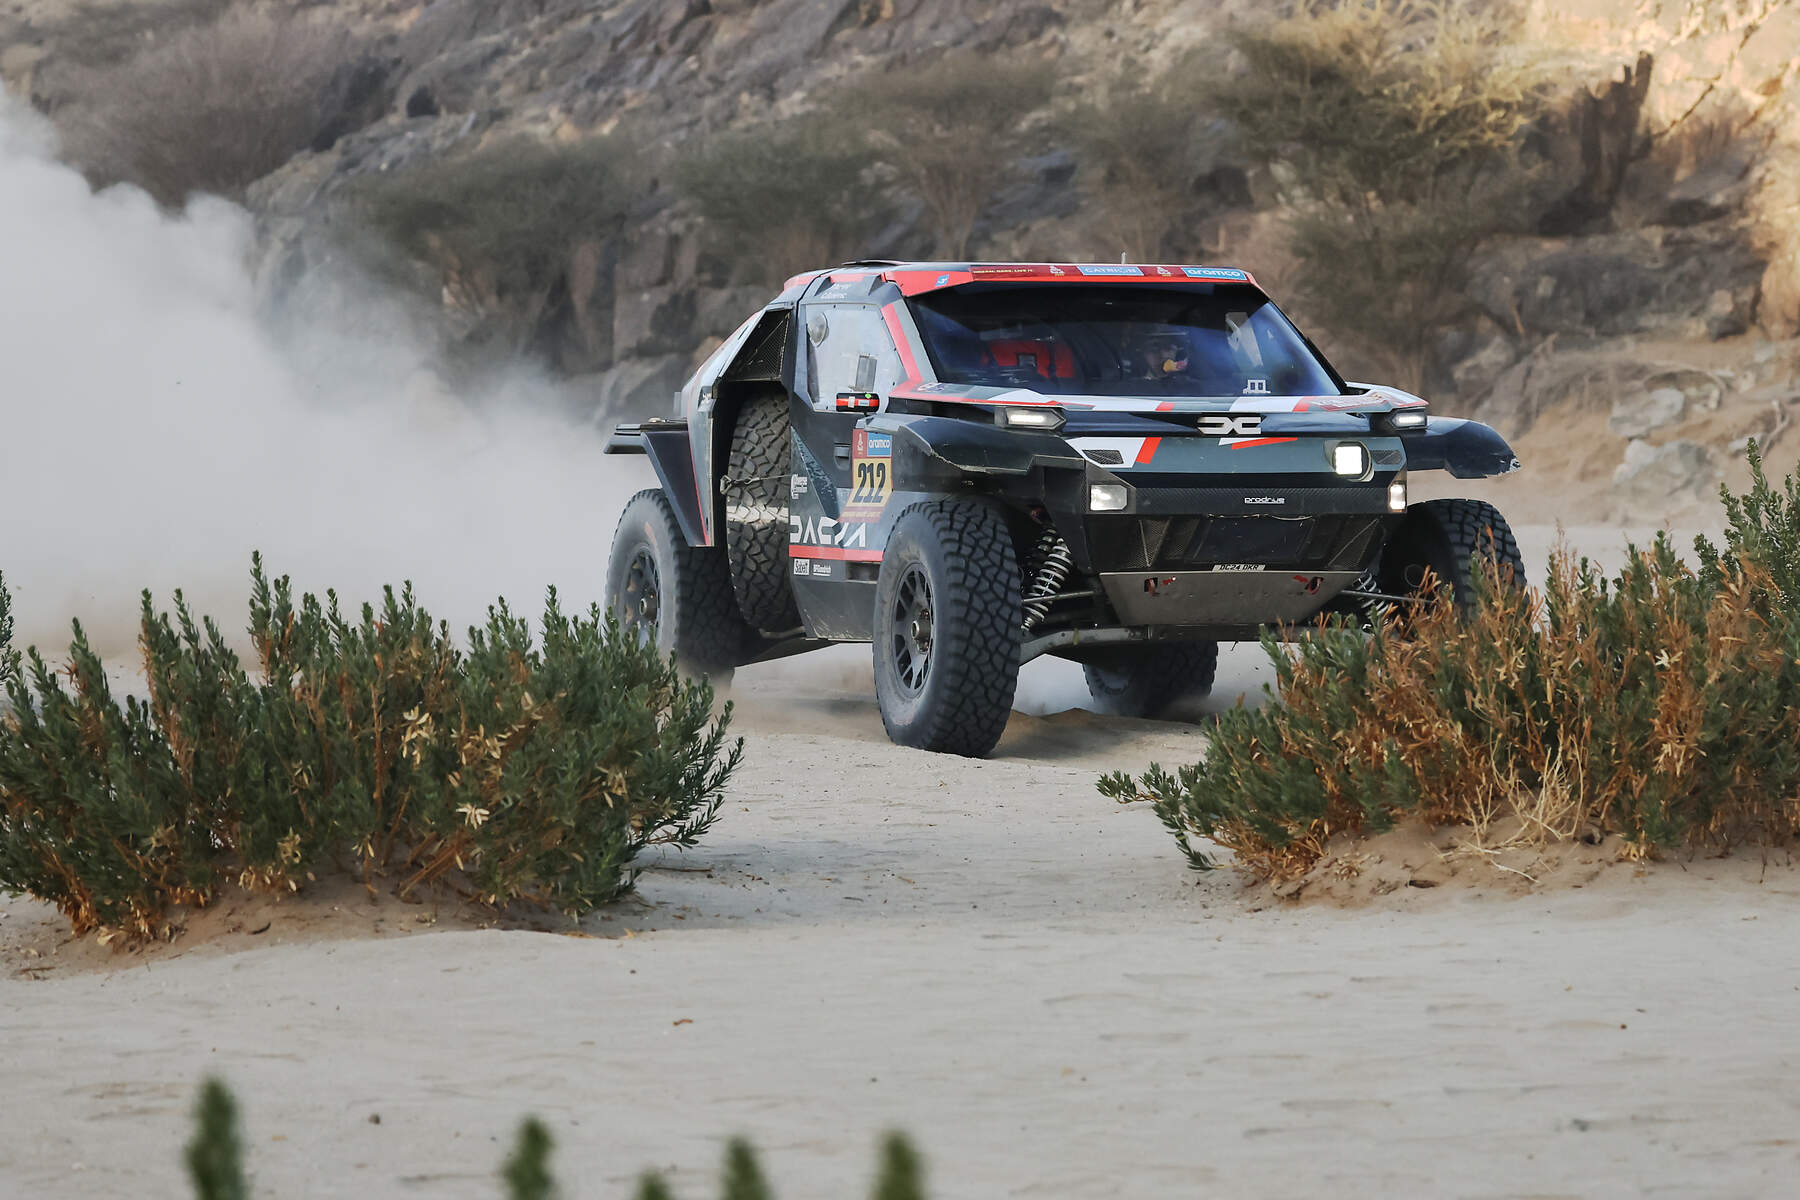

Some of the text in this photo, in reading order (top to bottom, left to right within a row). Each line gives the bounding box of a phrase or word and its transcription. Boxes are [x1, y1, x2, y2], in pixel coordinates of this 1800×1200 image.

[1187, 269, 1241, 277] aramco
[868, 439, 891, 449] aramco
[852, 462, 886, 503] 212
[790, 515, 866, 548] DACIA
